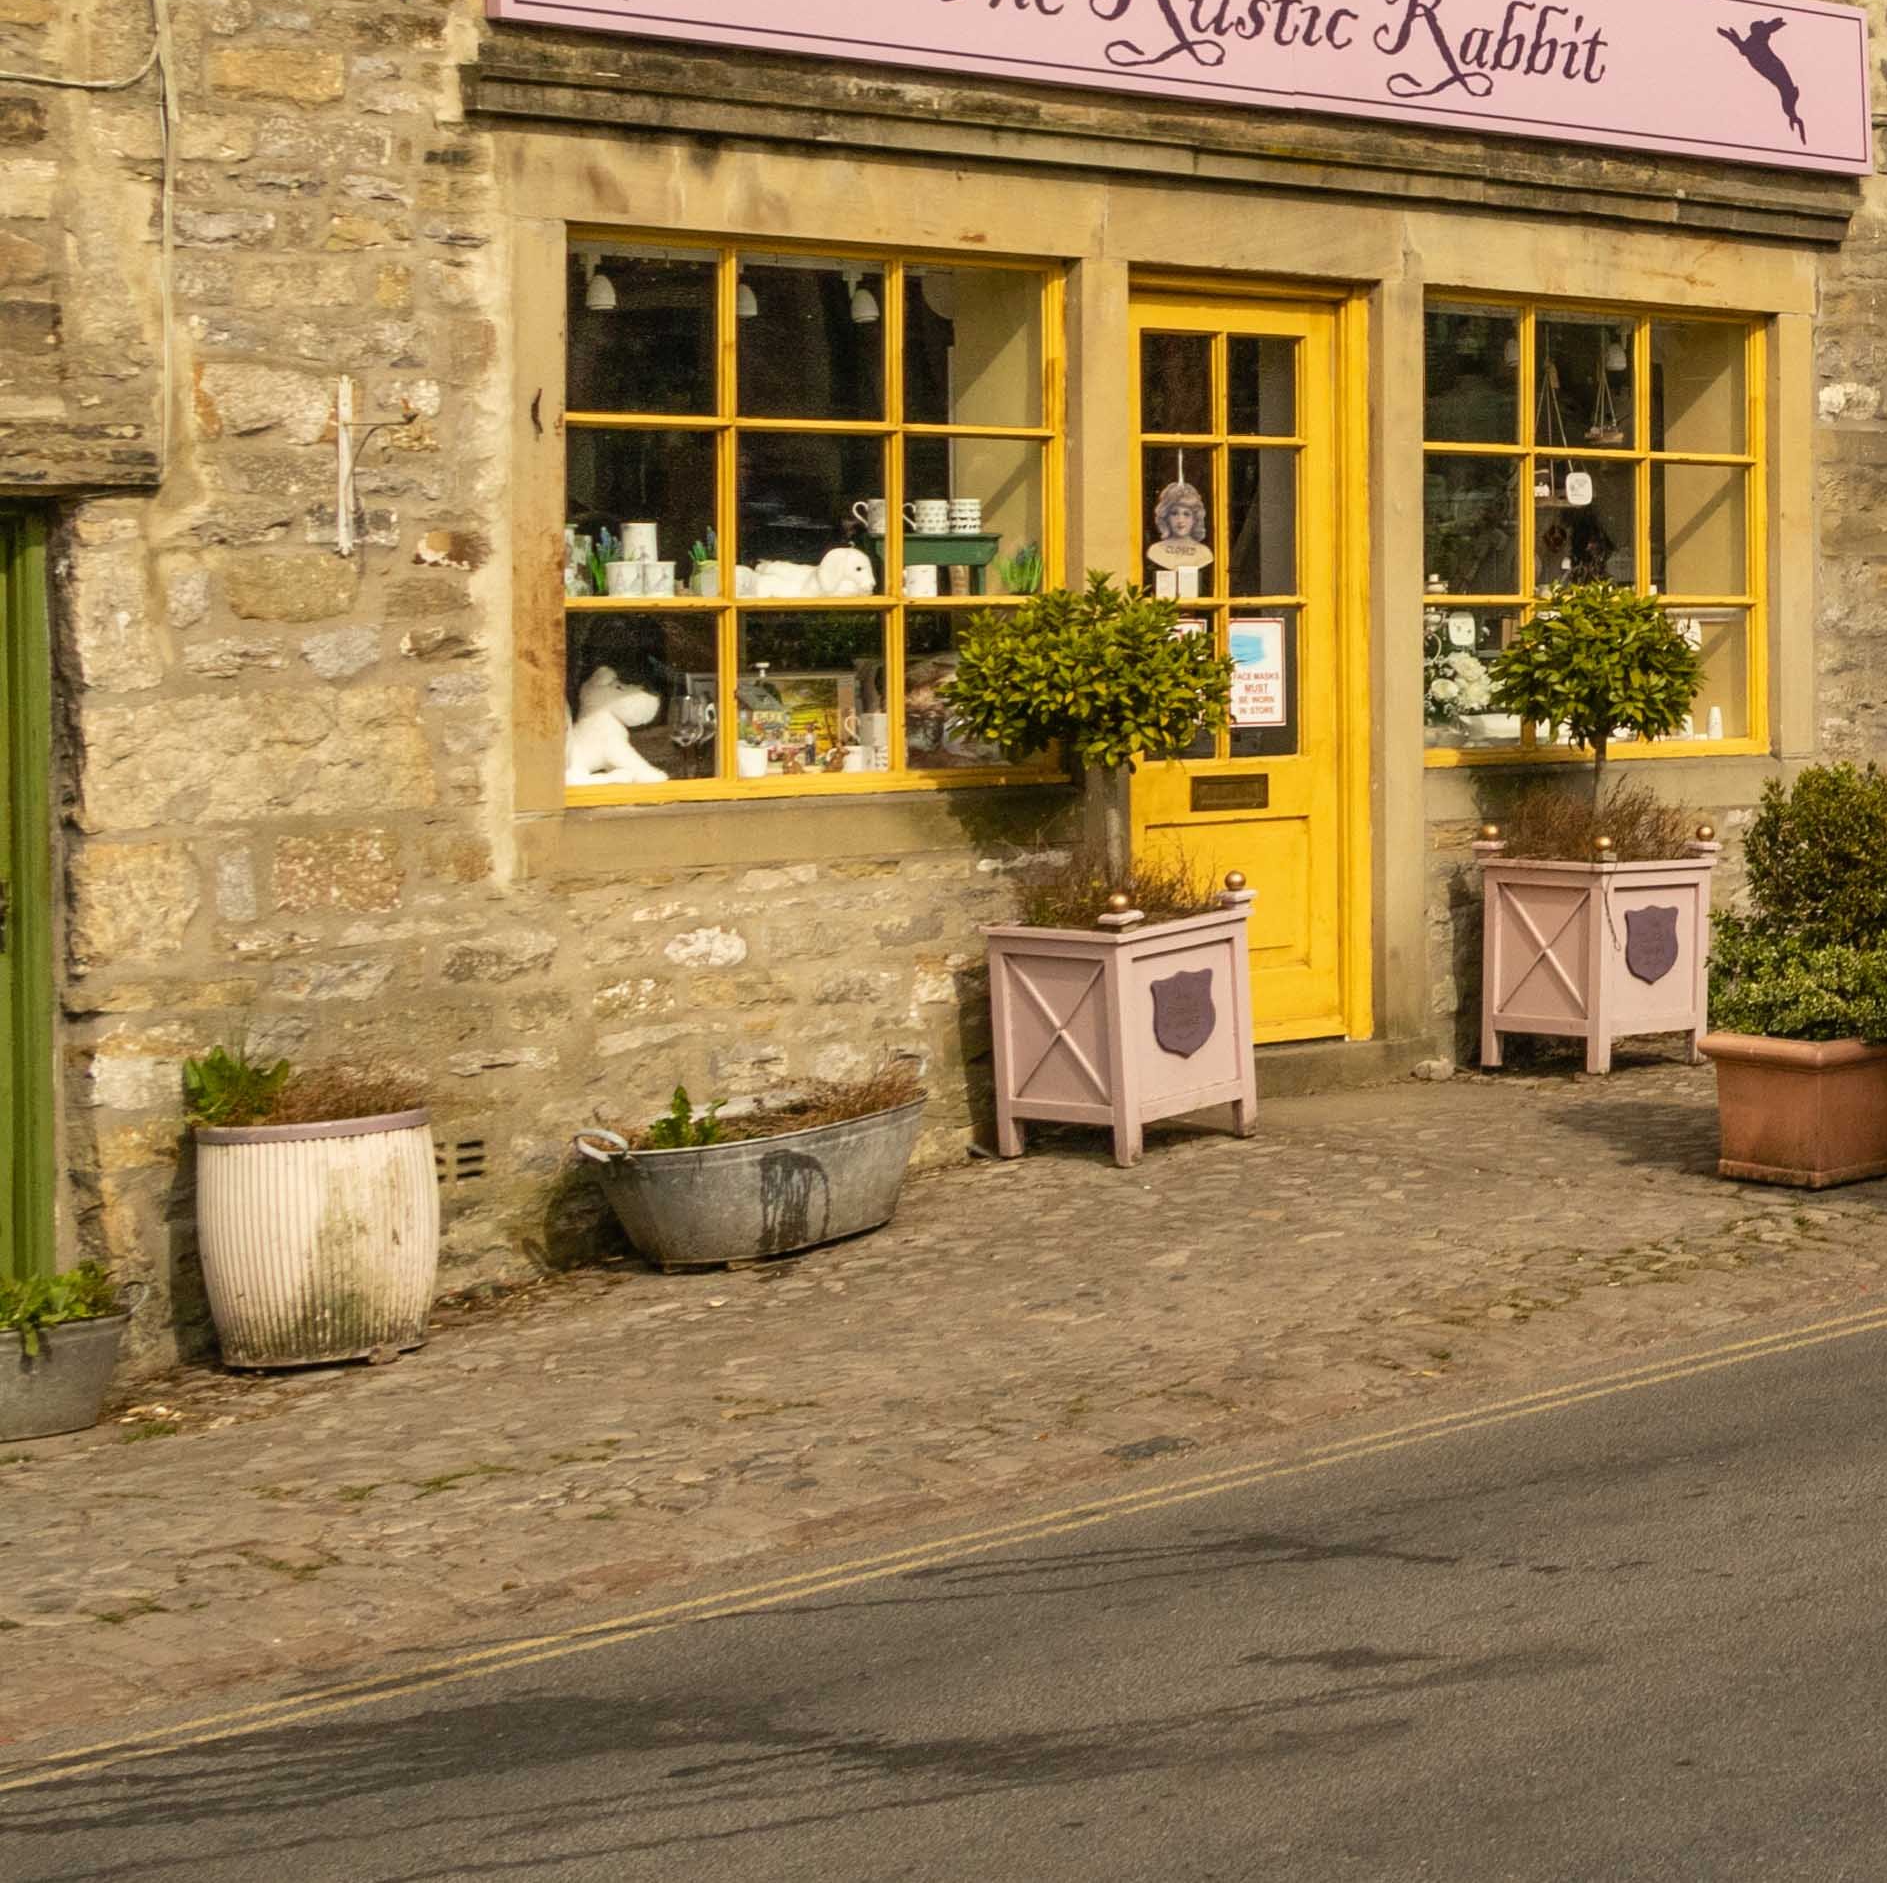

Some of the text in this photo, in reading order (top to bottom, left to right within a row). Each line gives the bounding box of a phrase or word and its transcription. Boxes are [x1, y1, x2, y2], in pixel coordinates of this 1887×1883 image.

[1232, 672, 1279, 681] FACE MASKS
[1244, 684, 1269, 694] MUST
[1238, 695, 1275, 705] BE WORN
[1239, 705, 1275, 715] IN STORE
